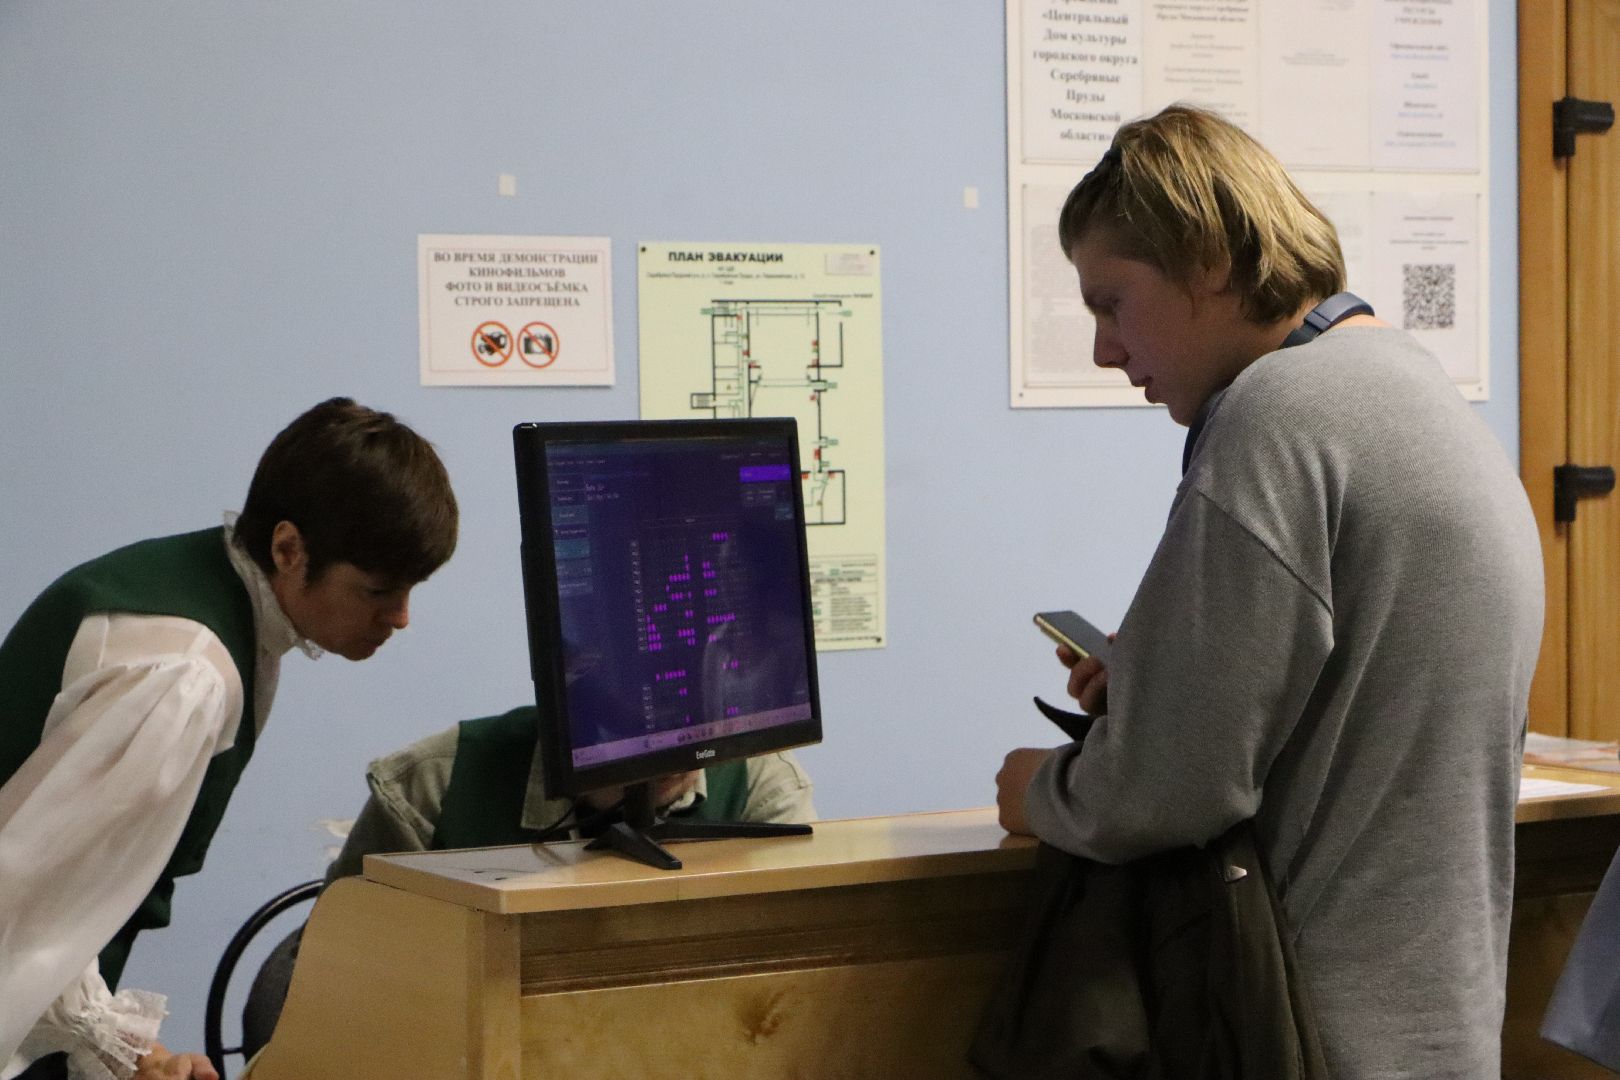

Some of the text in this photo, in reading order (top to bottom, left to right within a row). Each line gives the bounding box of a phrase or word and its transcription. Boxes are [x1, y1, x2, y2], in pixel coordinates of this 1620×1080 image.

[1042, 9, 1129, 25] «Центральный
[1043, 28, 1127, 46] Дом культуры
[1033, 49, 1138, 66] городского округа
[1050, 68, 1121, 84] Серебряные
[1066, 89, 1105, 103] Пруды
[1050, 108, 1121, 122] Московской
[433, 252, 598, 265] ВО ВРЕМЯ ДЕМОНСТРАЦИИ
[668, 251, 784, 263] ПЛАН ЭВАКУАЦИИ
[468, 267, 566, 278] КИНОФИЛЬМОВ
[445, 281, 589, 293] ФОТО И ВИДЕОСЪЁМКА
[454, 296, 580, 308] СТРОГО ЗАПРЕЩЕНА
